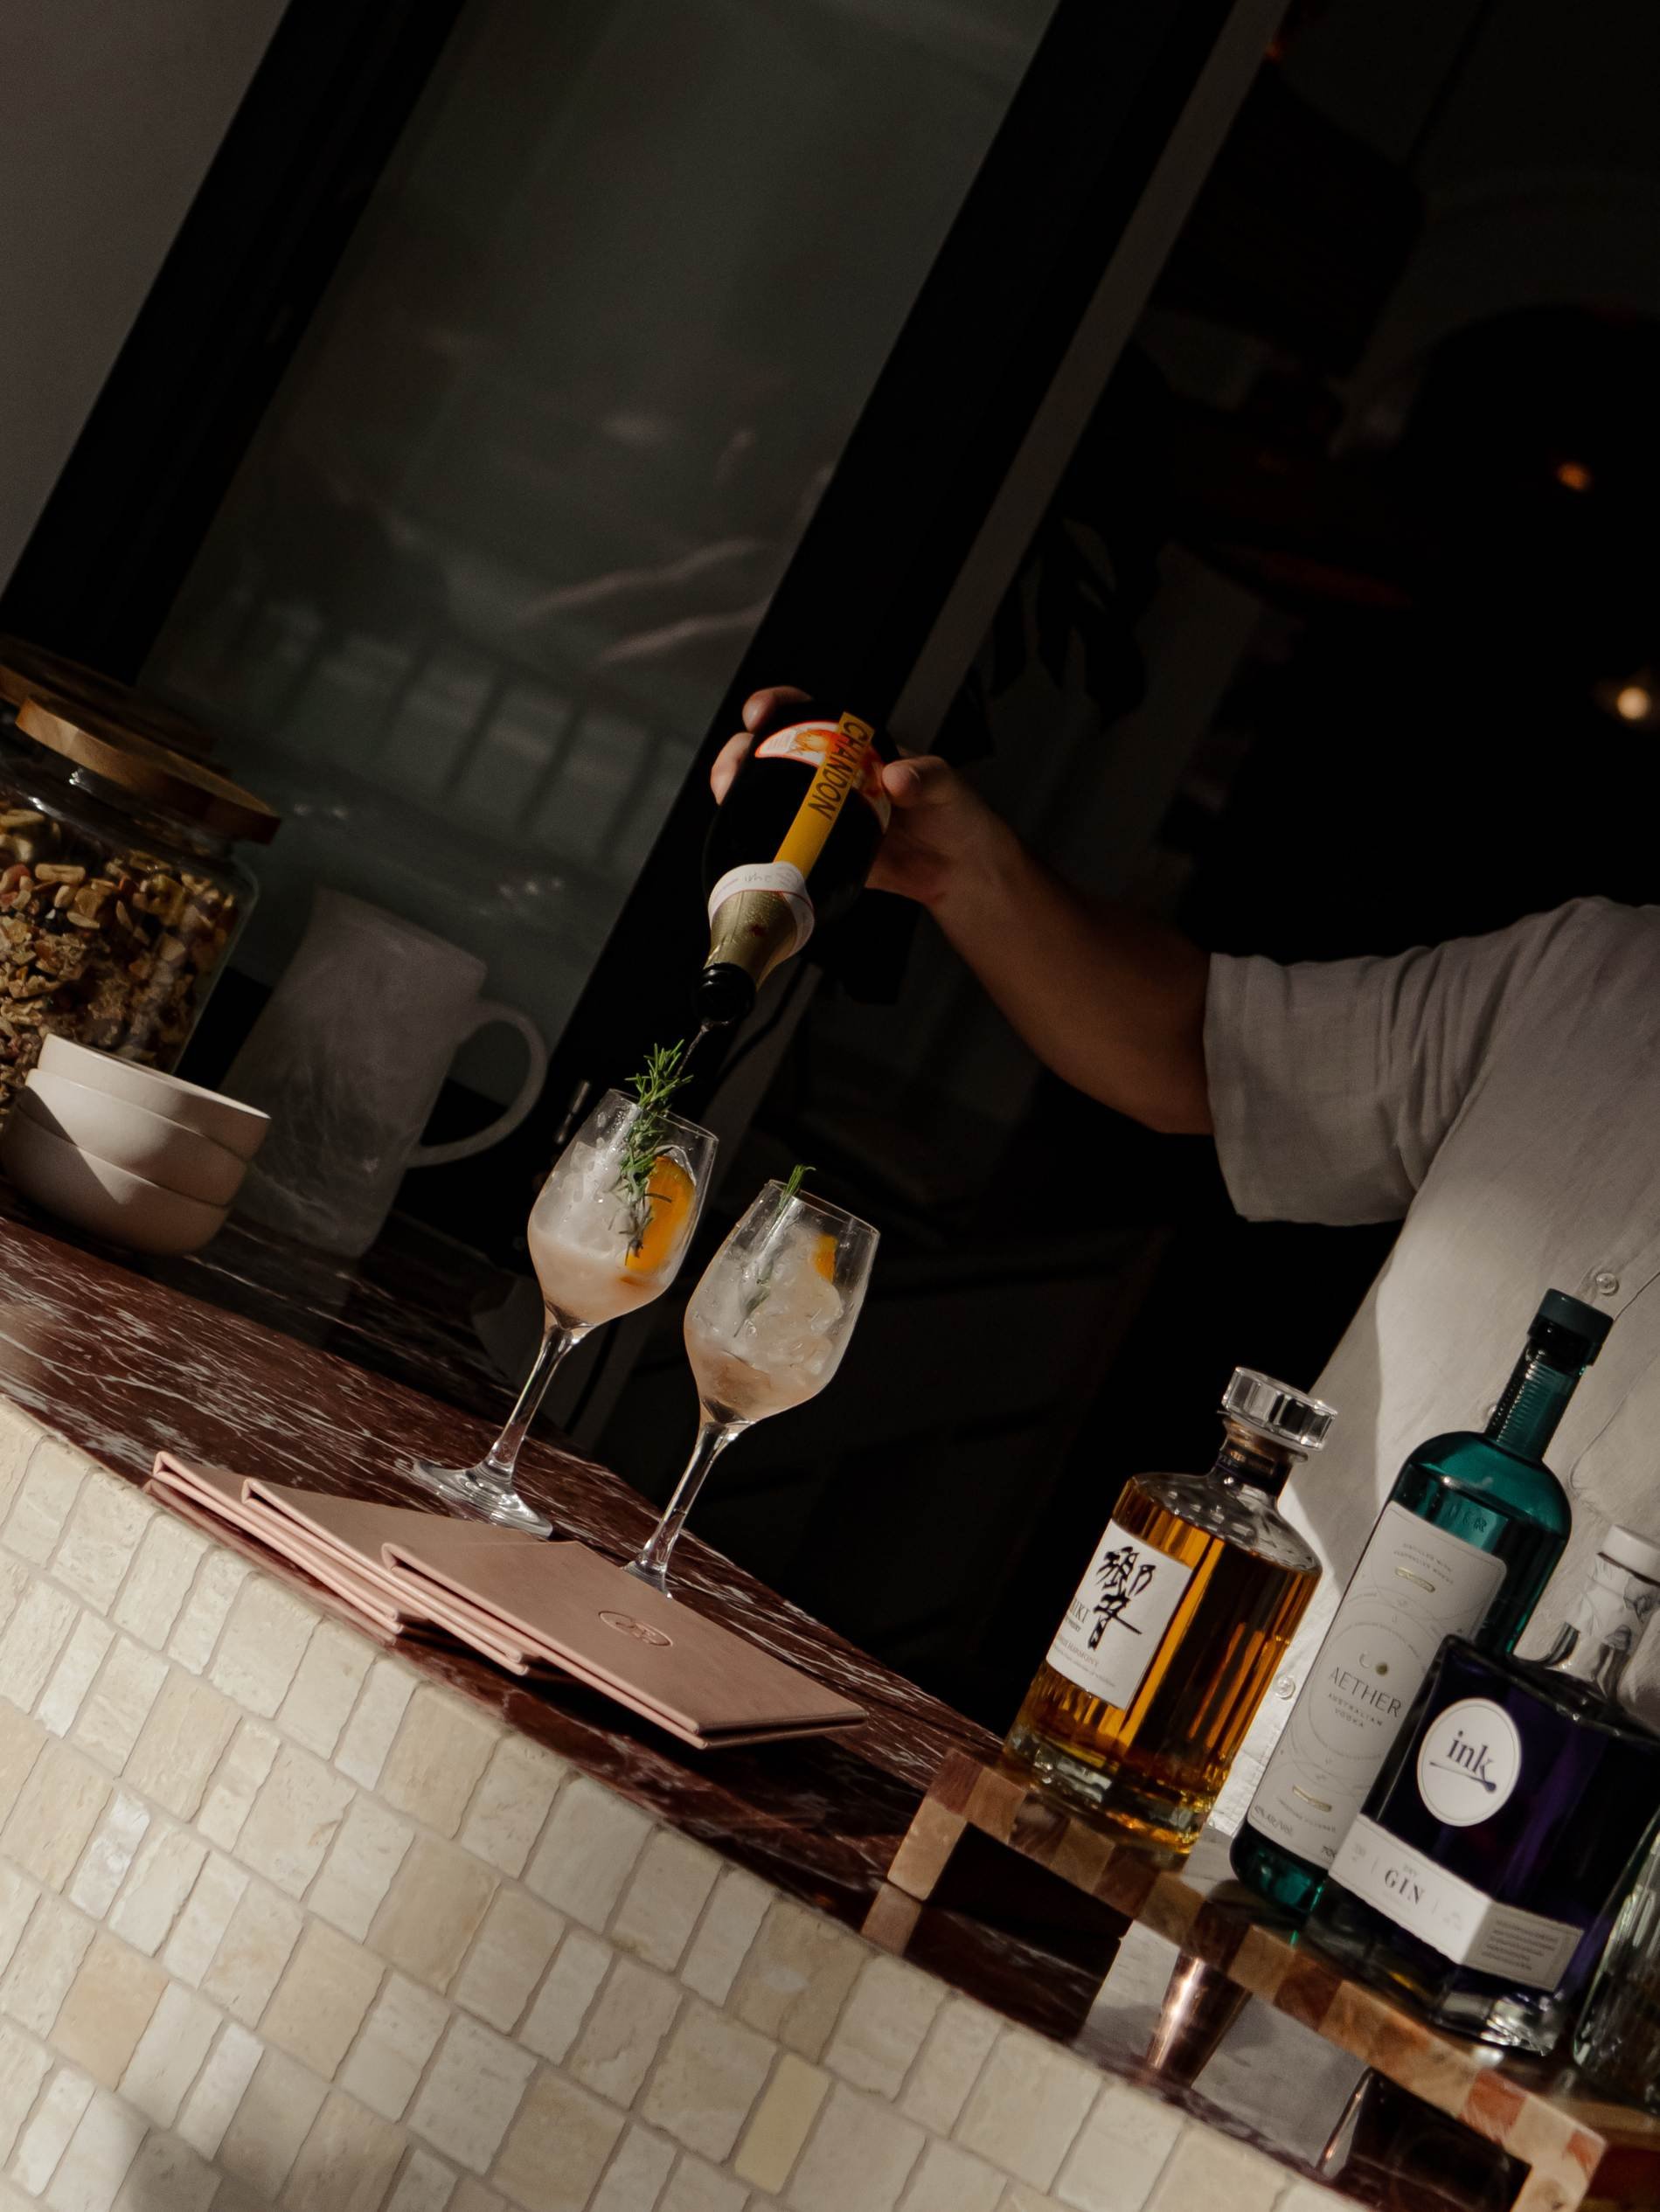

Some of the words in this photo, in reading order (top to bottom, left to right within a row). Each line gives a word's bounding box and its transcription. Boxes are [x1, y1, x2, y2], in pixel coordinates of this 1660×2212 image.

[808, 722, 870, 821] CHANDON
[1329, 1667, 1402, 1718] AETHER
[1329, 1692, 1384, 1727] AUSTRALIAN
[1335, 1707, 1364, 1729] VODKA
[1447, 1730, 1494, 1783] ink
[1385, 1868, 1426, 1905] GIN
